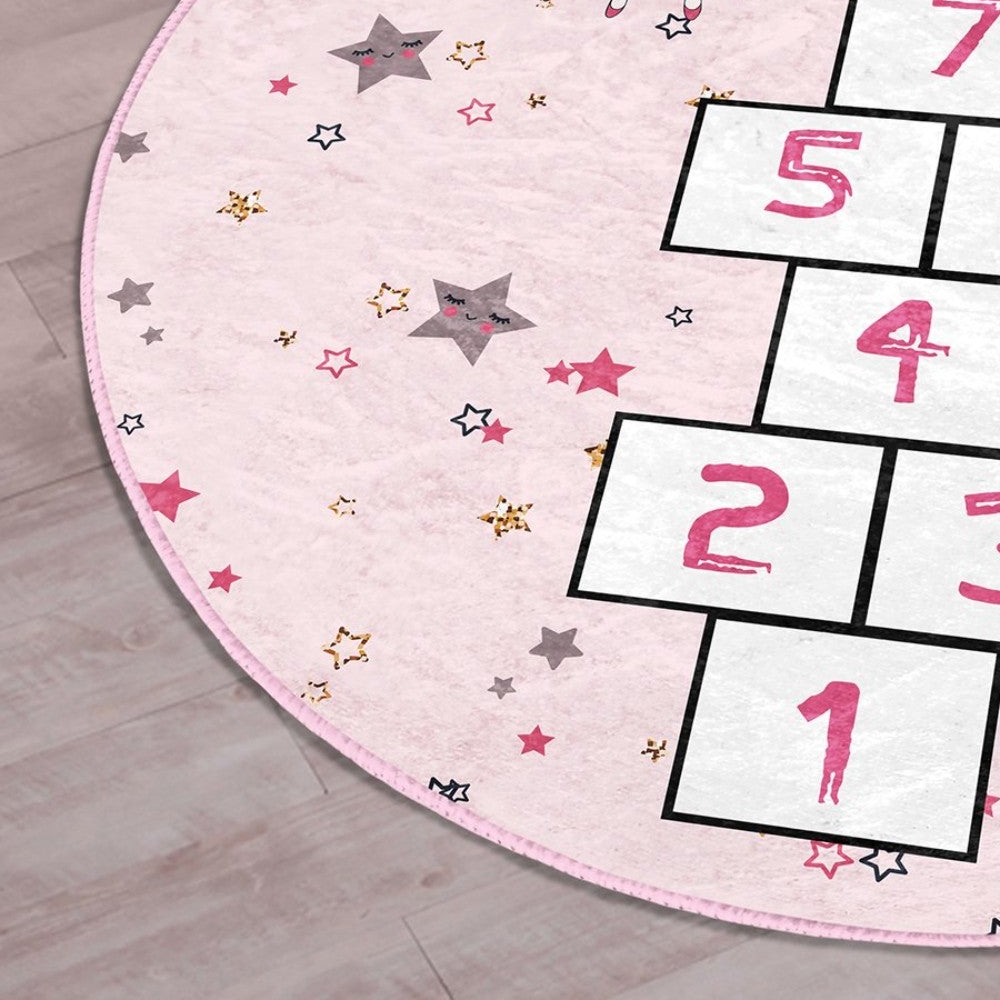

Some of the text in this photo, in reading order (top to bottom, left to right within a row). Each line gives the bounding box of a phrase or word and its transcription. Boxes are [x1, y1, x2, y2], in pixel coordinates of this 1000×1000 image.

[764, 130, 863, 220] 5
[857, 300, 951, 405] 4
[683, 463, 790, 576] 2
[797, 681, 861, 806] 1
